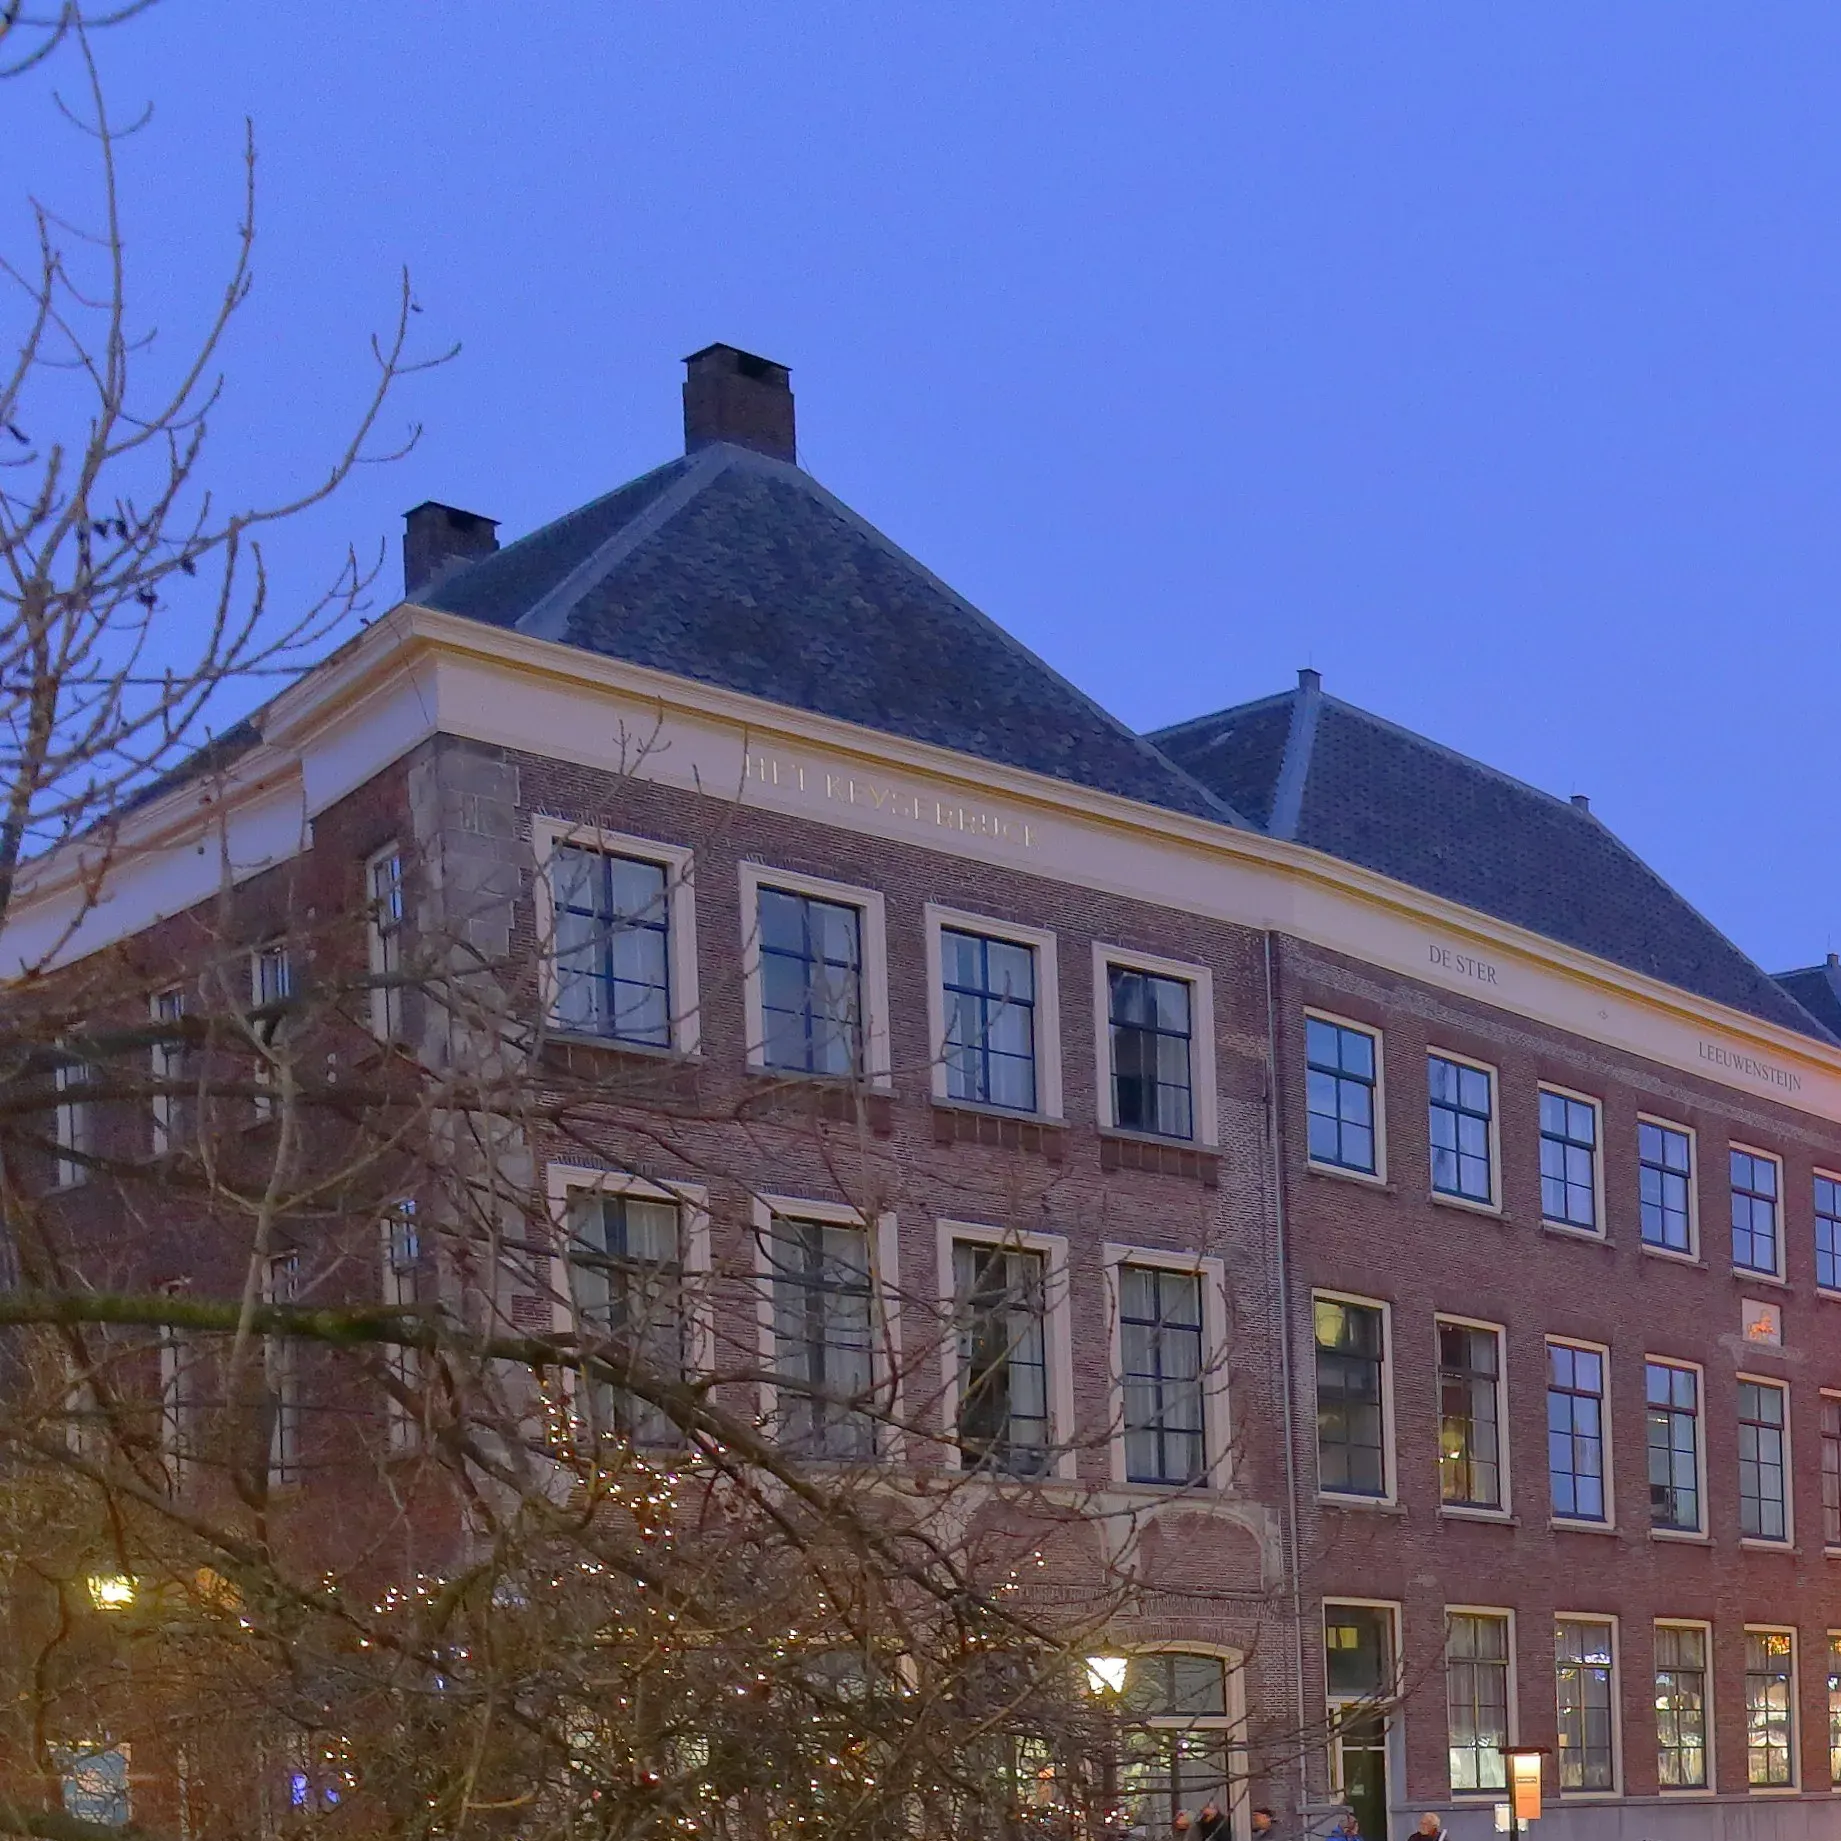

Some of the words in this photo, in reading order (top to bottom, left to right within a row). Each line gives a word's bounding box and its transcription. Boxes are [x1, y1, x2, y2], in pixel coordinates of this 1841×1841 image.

[1428, 944, 1452, 968] DE
[1456, 954, 1498, 985] STER
[1698, 1040, 1802, 1093] LEEUWENSTEIJN
